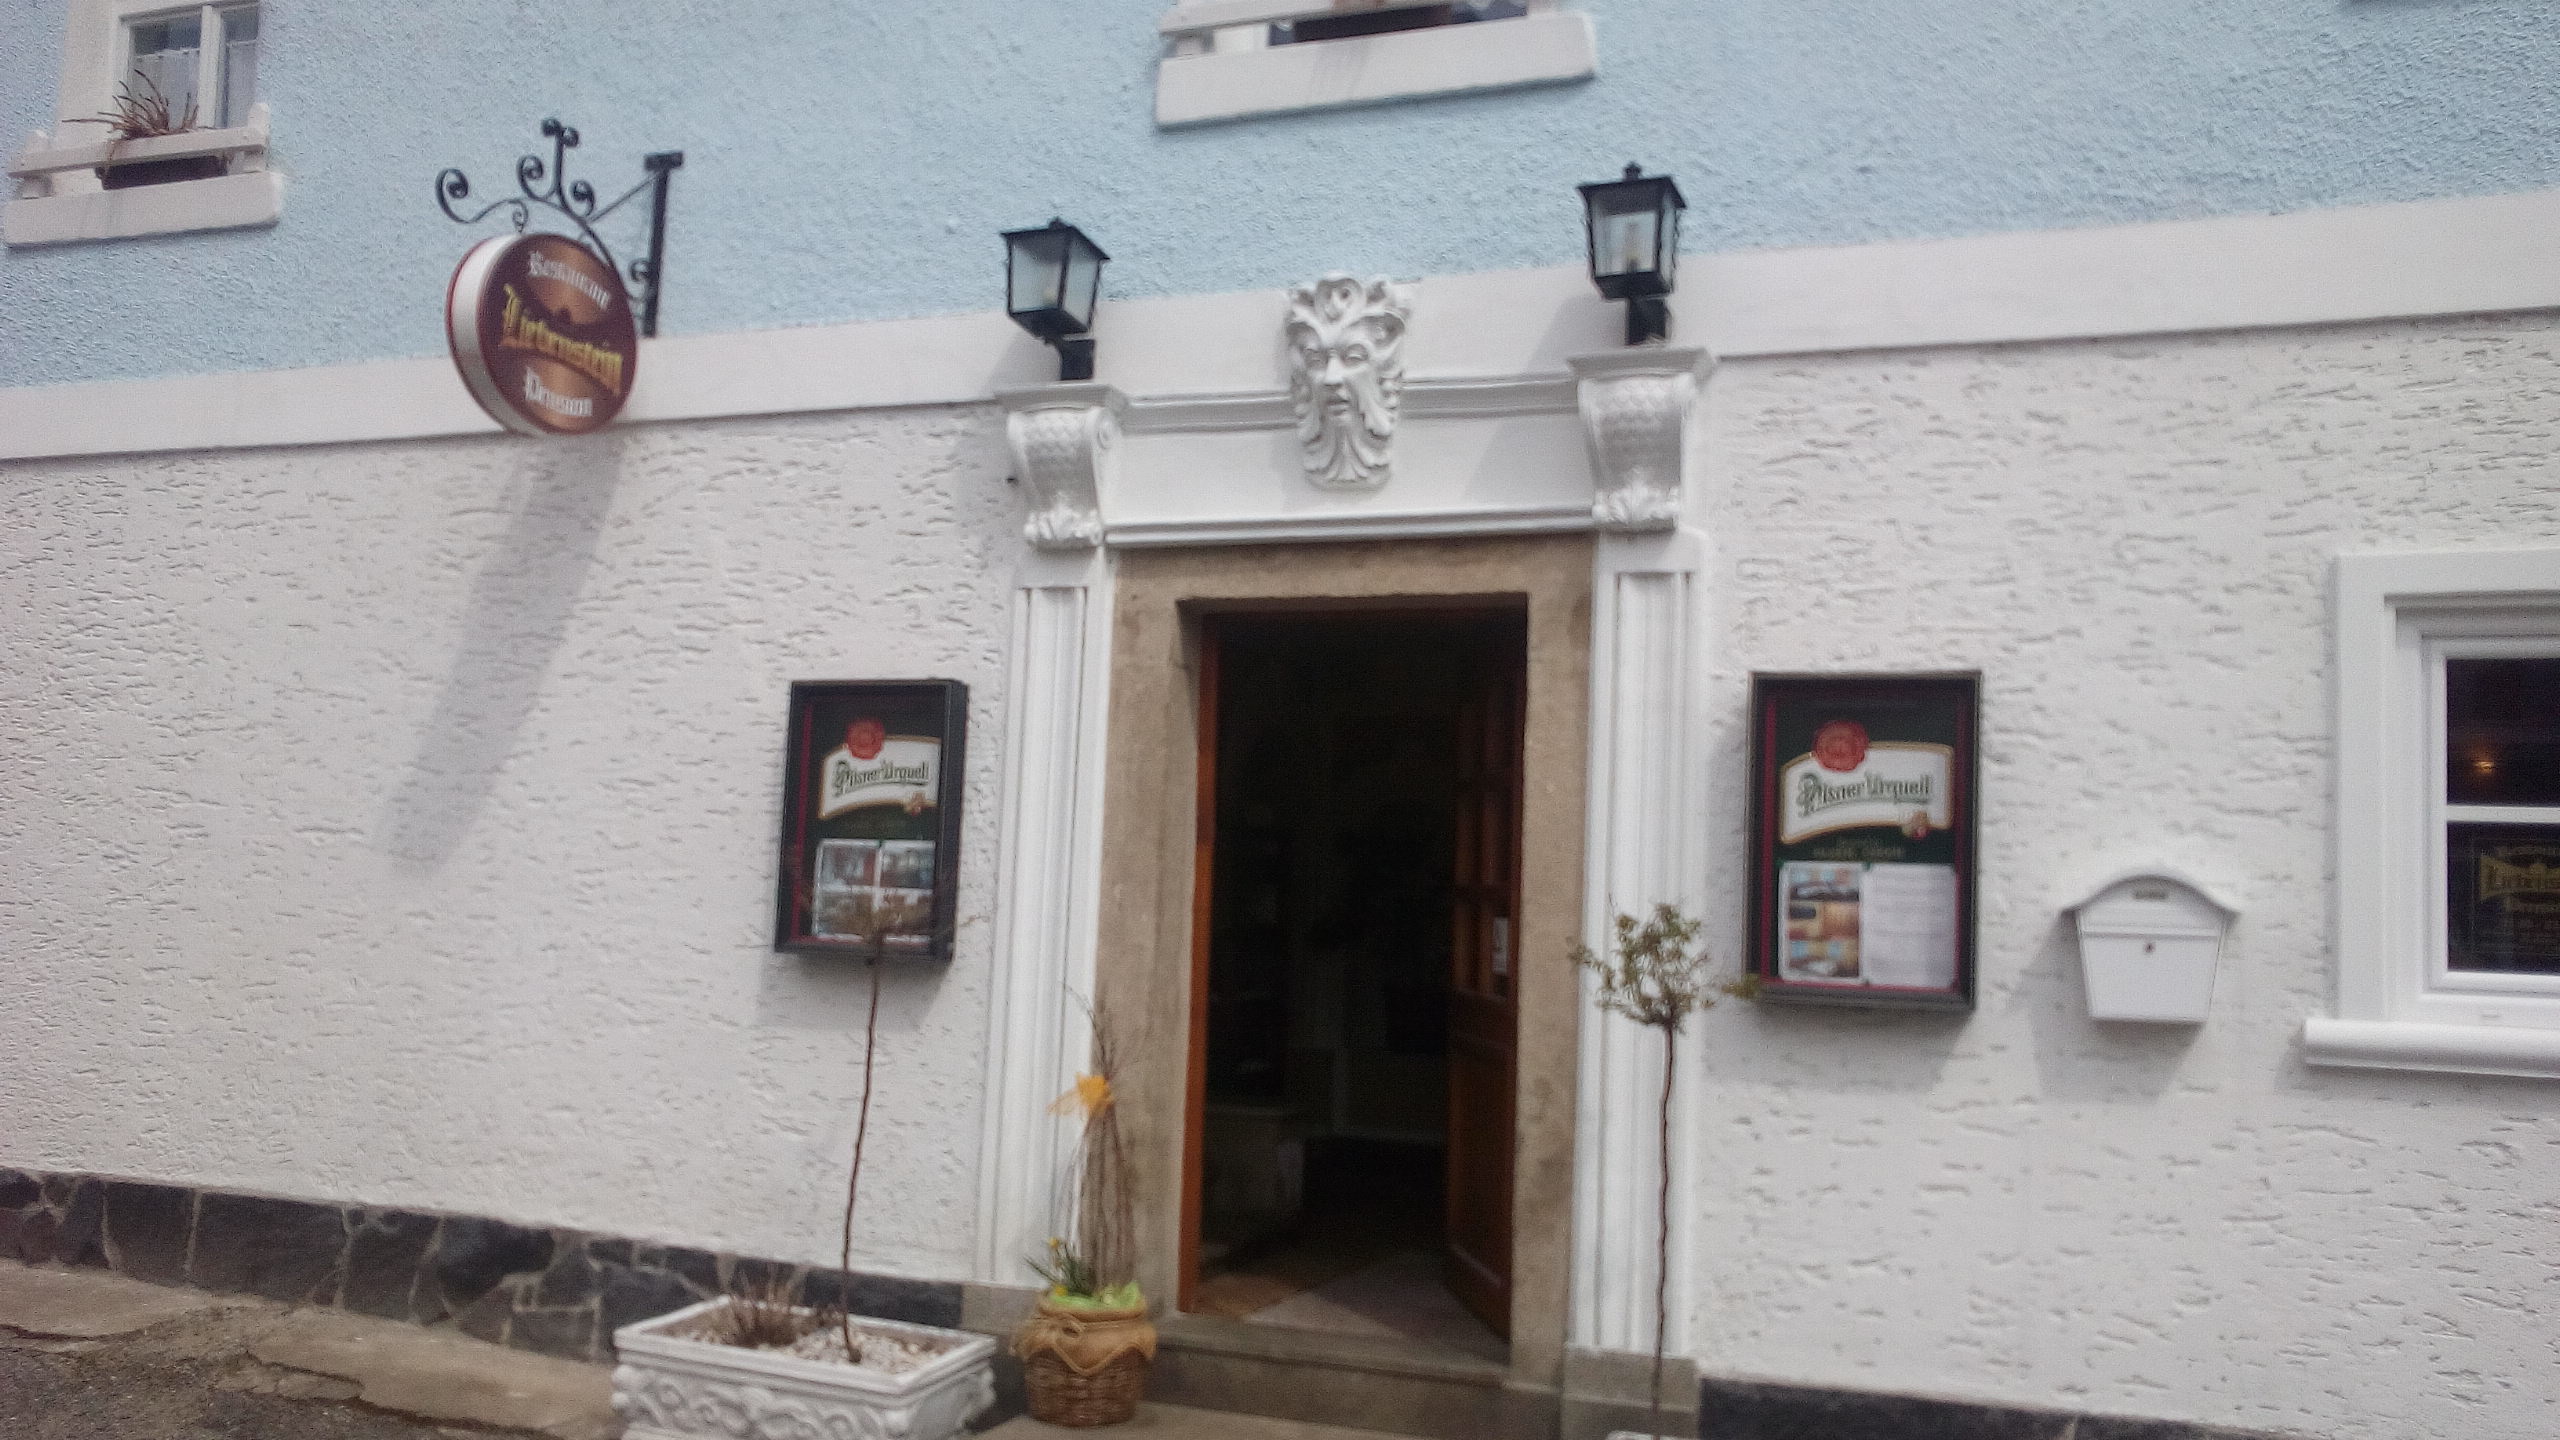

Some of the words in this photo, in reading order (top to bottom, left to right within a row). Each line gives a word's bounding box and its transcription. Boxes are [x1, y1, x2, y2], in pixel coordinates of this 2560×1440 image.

[832, 759, 881, 797] Pilsner
[880, 758, 930, 785] Urquell
[1796, 772, 1864, 817] Pilsner
[1864, 770, 1932, 803] Urquell
